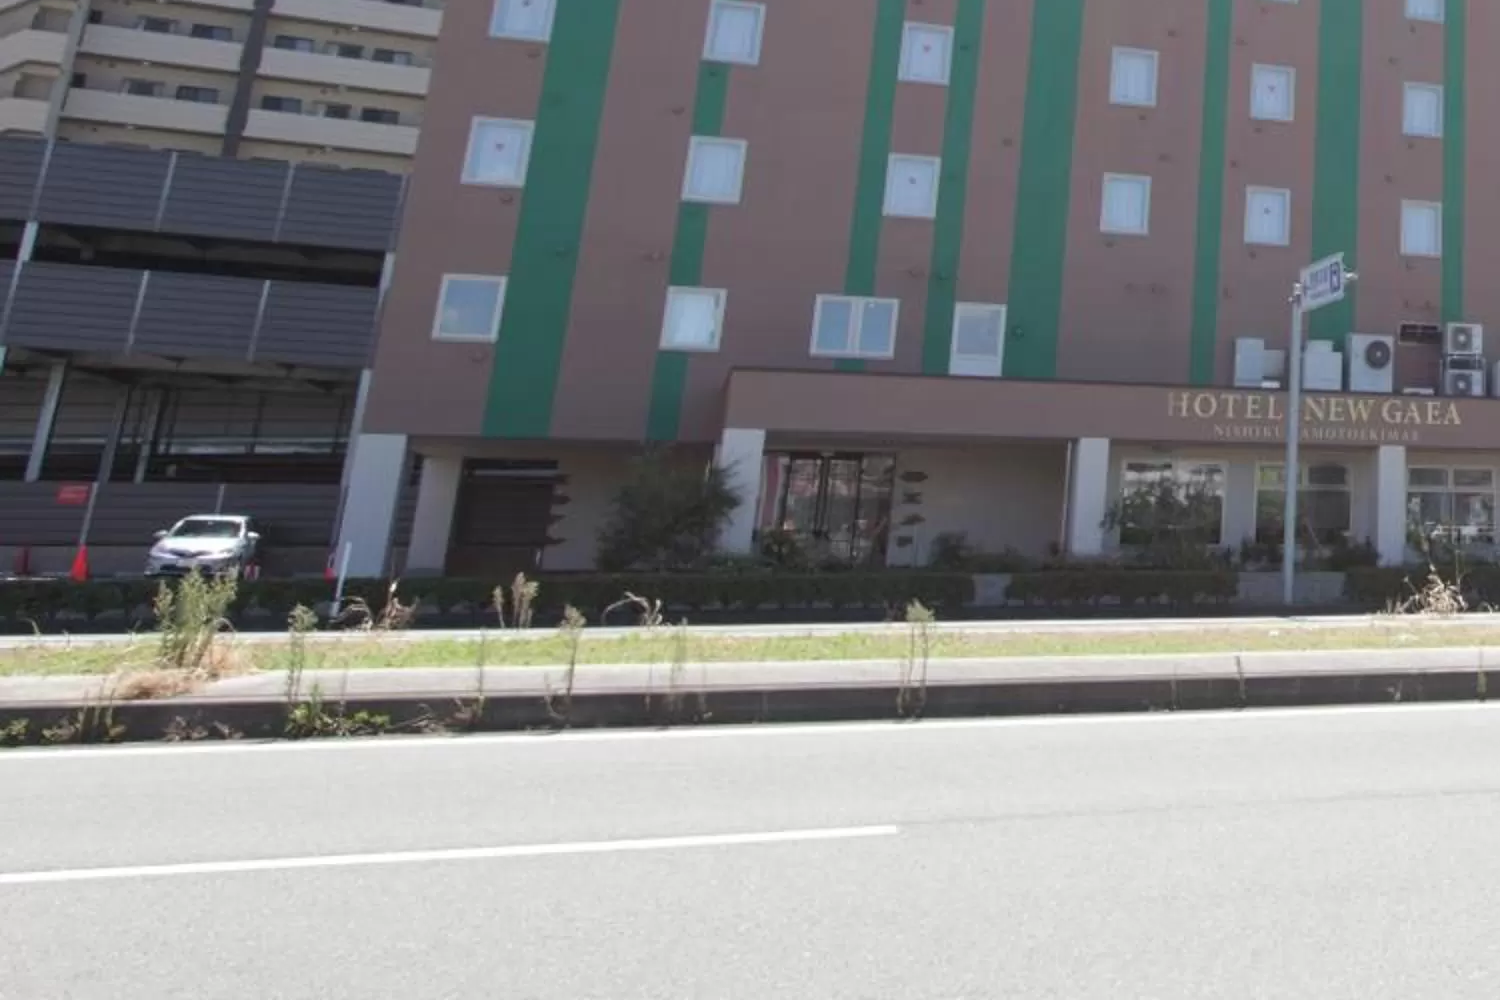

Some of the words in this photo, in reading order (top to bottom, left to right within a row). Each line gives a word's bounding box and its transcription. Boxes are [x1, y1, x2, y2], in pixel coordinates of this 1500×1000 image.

[1167, 391, 1284, 420] HOTEL
[1303, 396, 1376, 424] NEW
[1381, 399, 1462, 426] GAEA
